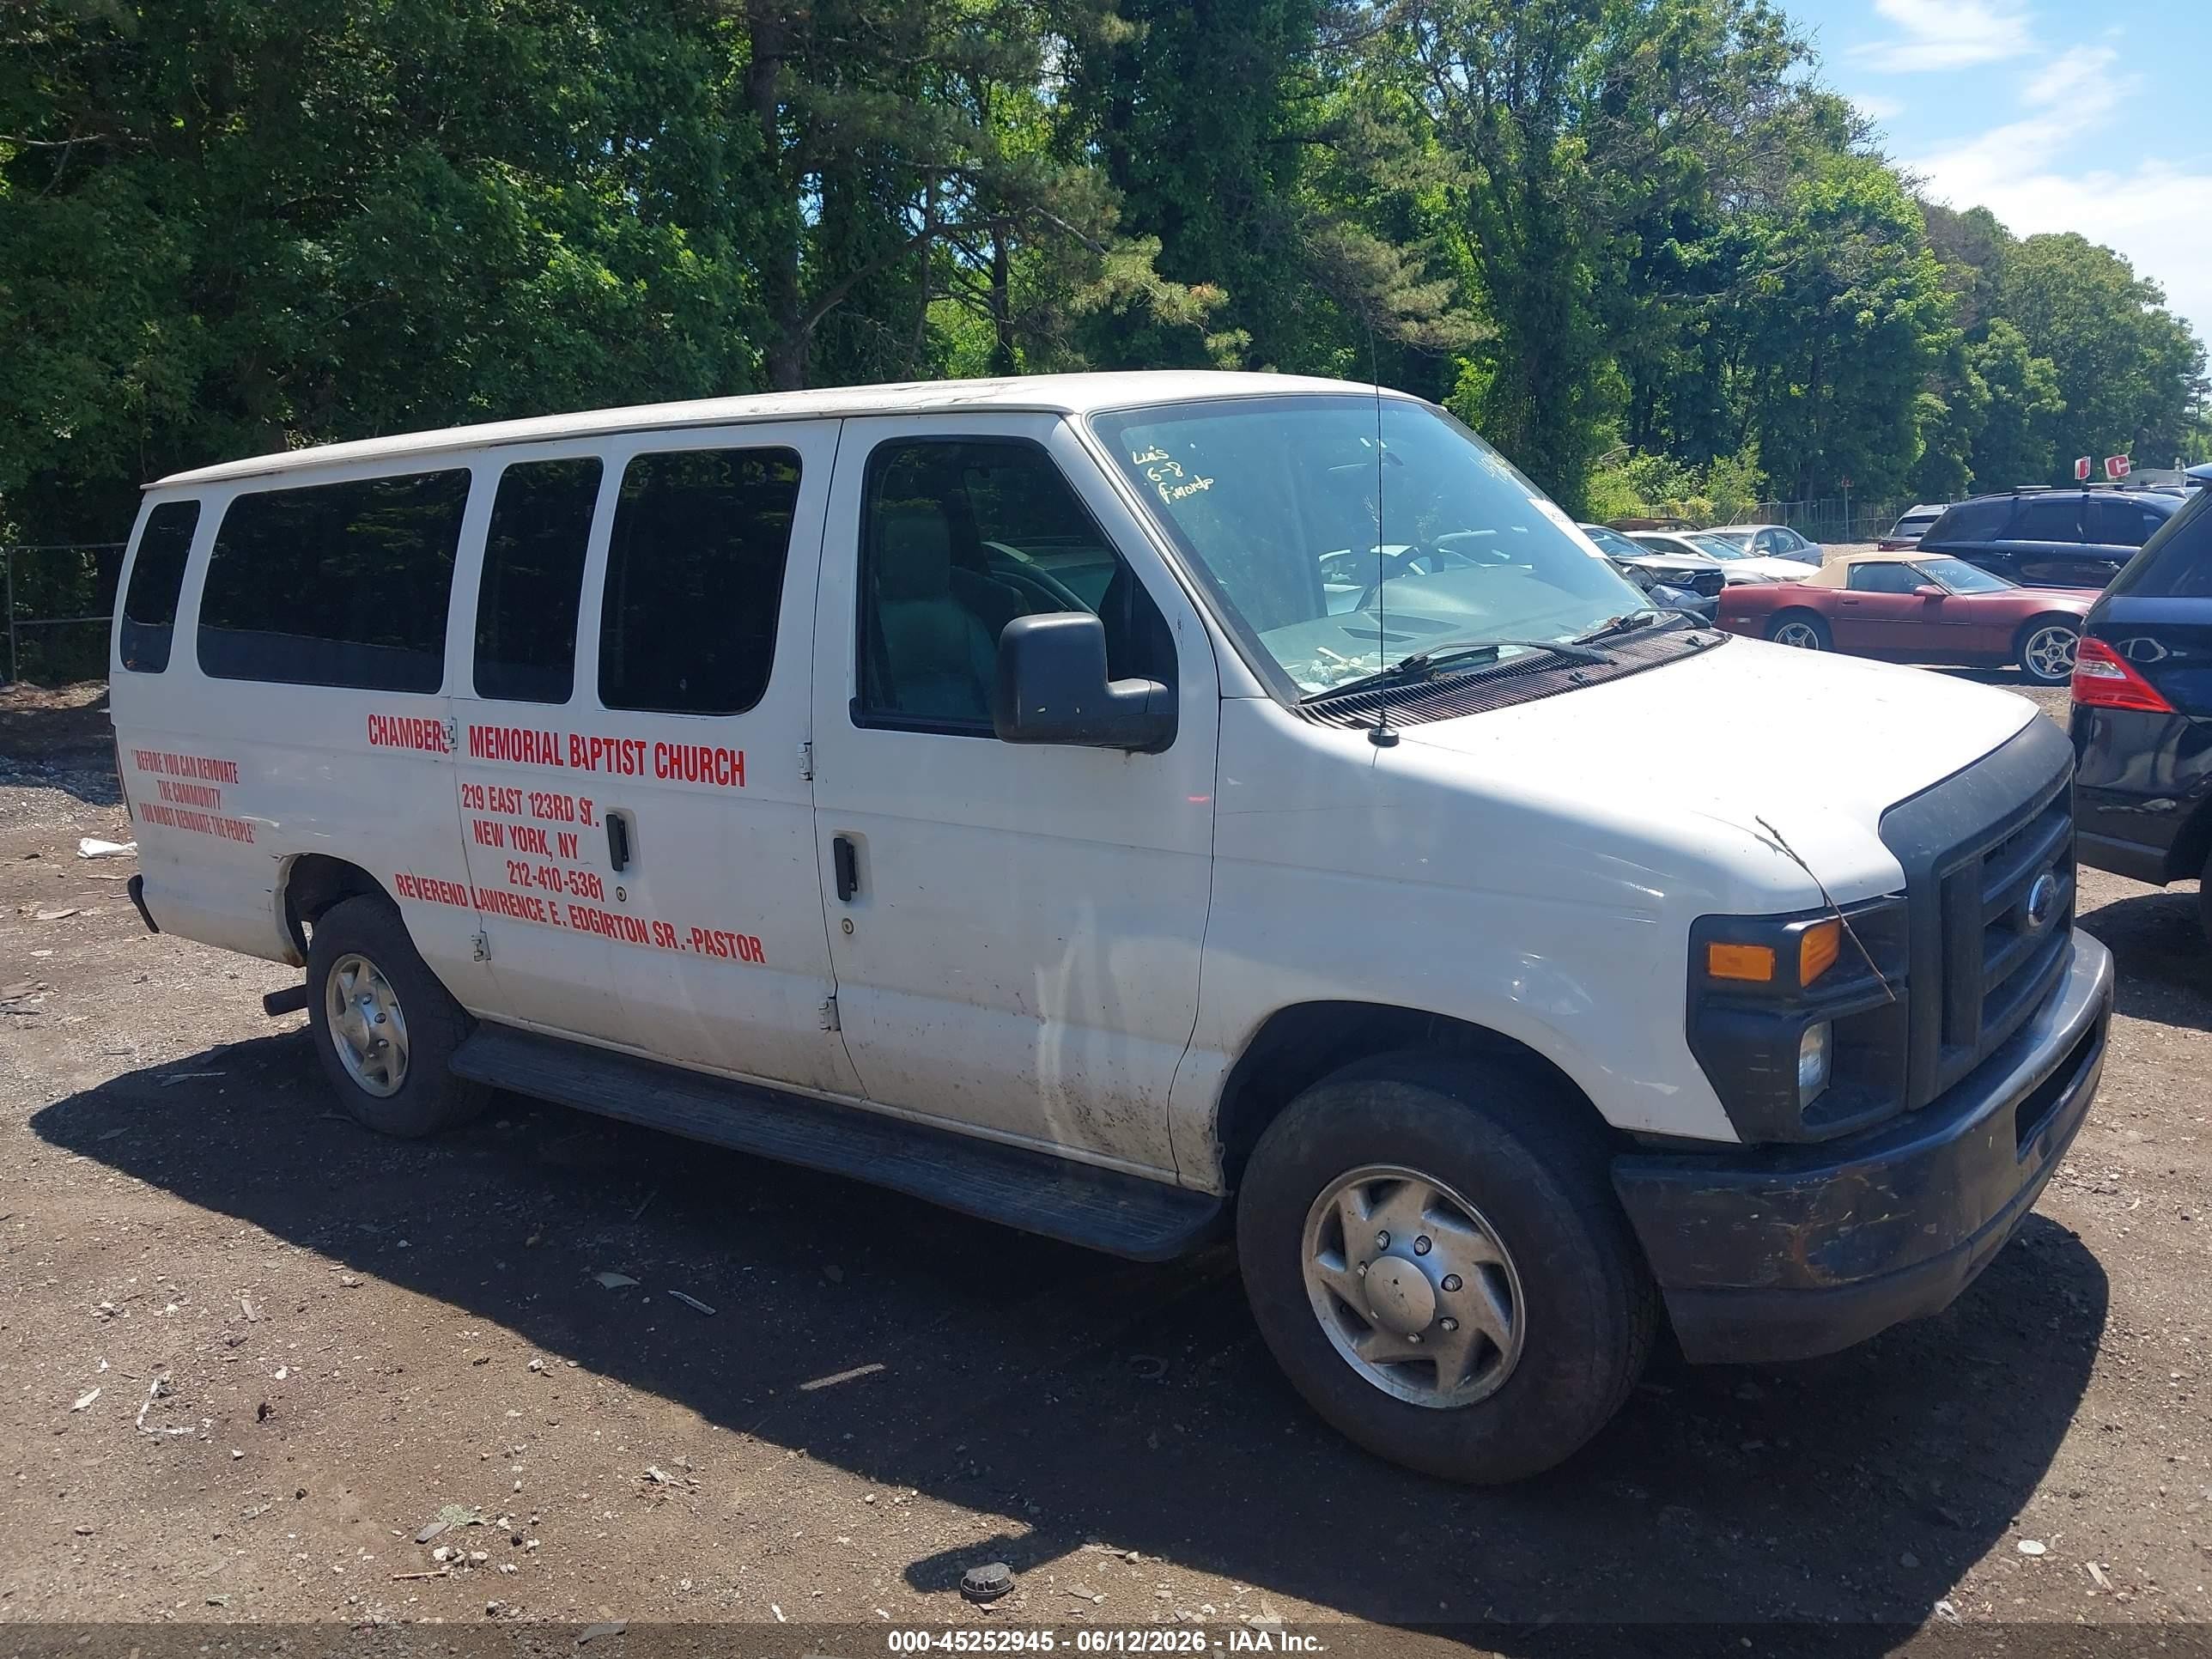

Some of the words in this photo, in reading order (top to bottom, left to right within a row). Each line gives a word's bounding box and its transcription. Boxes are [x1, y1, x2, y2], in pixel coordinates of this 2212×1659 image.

[1147, 461, 1183, 482] 6-8
[164, 752, 179, 775] YOU
[180, 756, 197, 778] CAN
[198, 758, 240, 784] RENOVATE
[469, 725, 563, 766] MEMORIAL
[569, 733, 647, 775] BAPTIST
[654, 742, 745, 787] CHURCH
[157, 780, 173, 801] THE
[172, 782, 221, 810] COMMUNITY
[461, 783, 484, 810] 219
[488, 786, 522, 815] EAST
[528, 792, 574, 822] 123RD
[579, 797, 599, 827] ST.
[139, 803, 155, 823] YOU
[154, 805, 176, 827] MUST
[175, 809, 212, 835] RENOVATE
[210, 816, 227, 838] THE
[473, 819, 504, 848] NEW
[508, 824, 554, 862] YORK,
[557, 831, 577, 860] NY
[507, 860, 605, 902] 212-410-5361
[395, 873, 468, 908] REVEREND
[470, 885, 547, 923] LAWRENCE
[548, 901, 567, 927] E.
[568, 904, 650, 945] EDGIRTON
